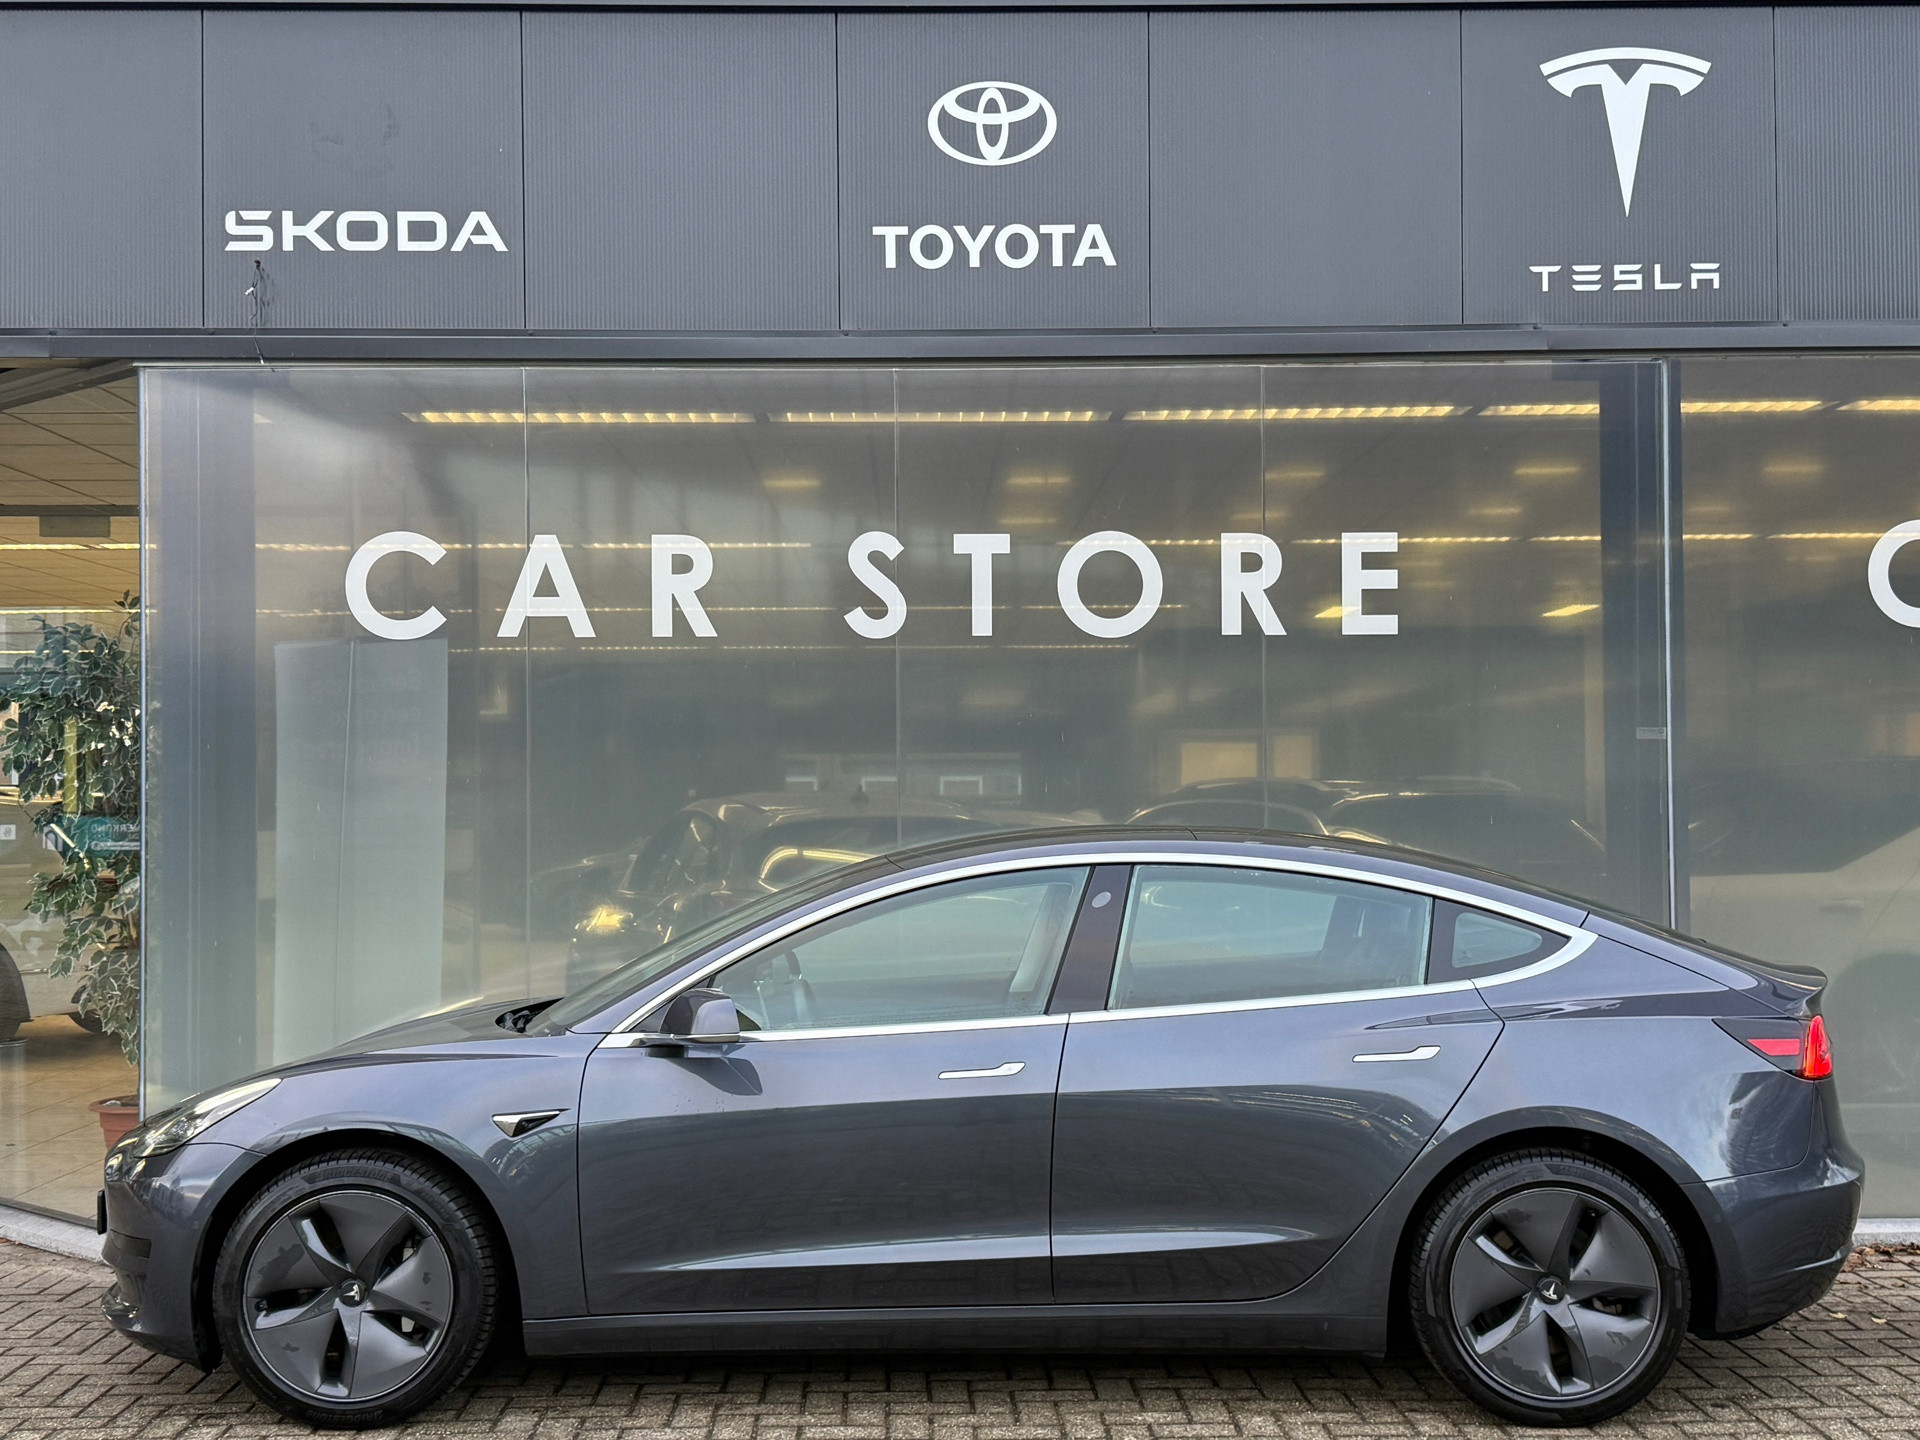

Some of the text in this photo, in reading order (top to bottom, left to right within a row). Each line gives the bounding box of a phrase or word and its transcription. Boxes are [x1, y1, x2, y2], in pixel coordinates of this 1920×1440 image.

[872, 223, 1117, 270] TOYOTA
[1529, 262, 1721, 292] TESLA
[346, 530, 1399, 640] CAR STORE
